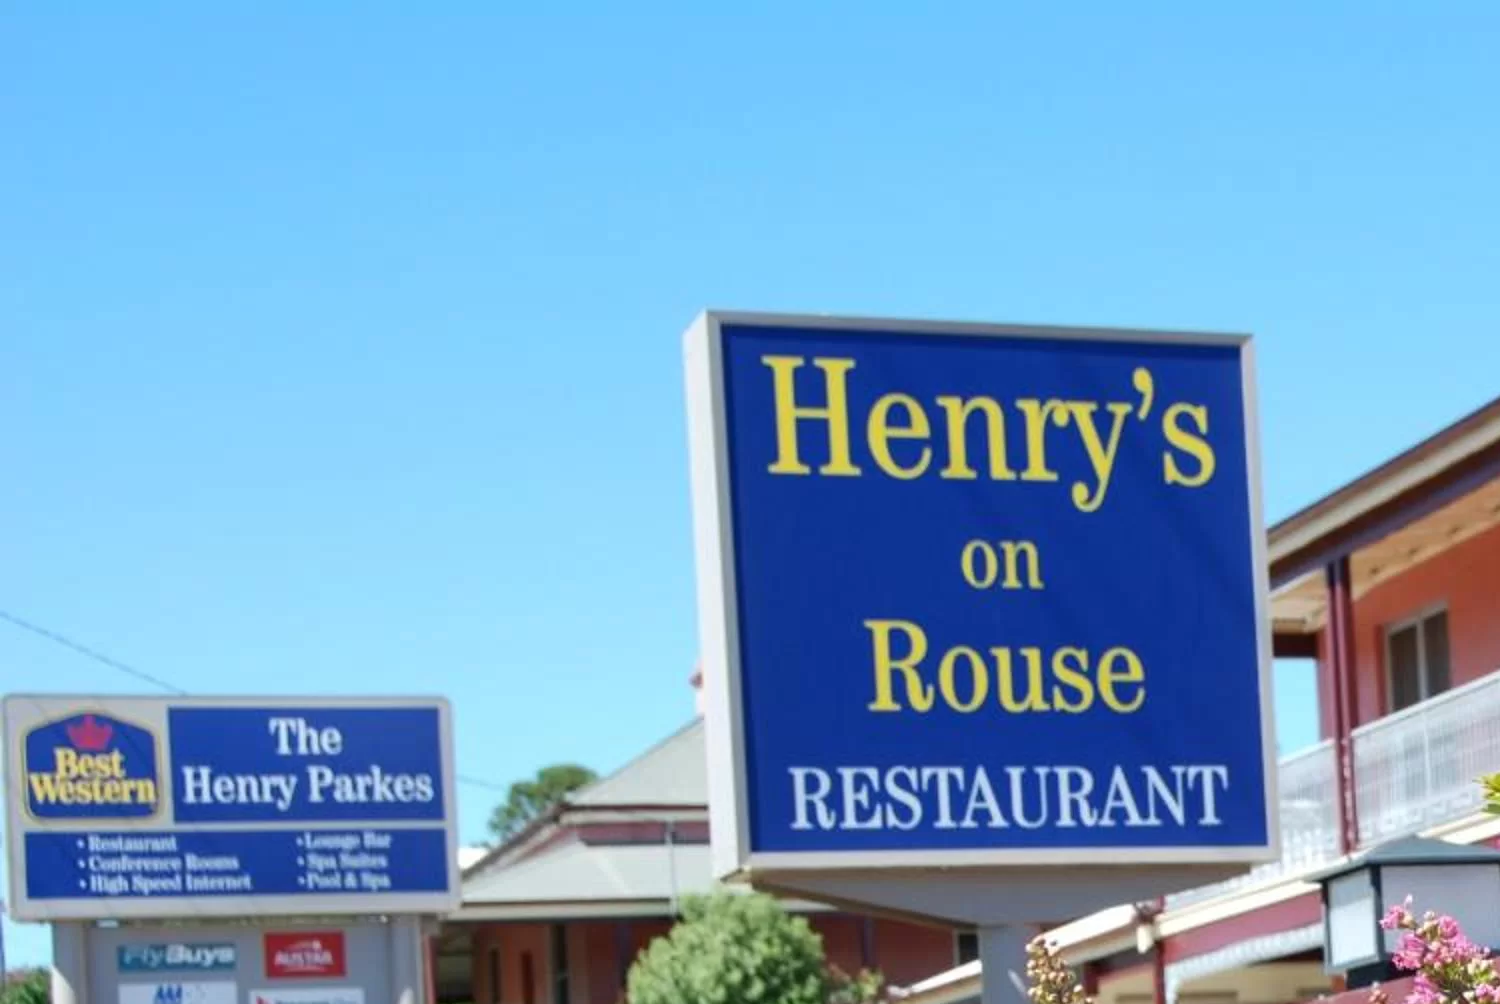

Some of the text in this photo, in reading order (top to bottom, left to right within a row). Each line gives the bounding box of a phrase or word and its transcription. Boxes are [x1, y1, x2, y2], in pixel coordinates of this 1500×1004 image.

[762, 354, 1216, 513] Henry's
[960, 538, 1044, 590] on
[863, 618, 1146, 714] Rouse
[269, 717, 343, 755] The
[54, 747, 125, 778] Best
[29, 773, 156, 805] Western
[181, 765, 434, 812] Henry Parkes
[788, 764, 1229, 831] RESTAURANT
[88, 834, 177, 852] Restaurant
[305, 832, 392, 853] Lounge Bar
[89, 854, 240, 872] Conference Rooms
[306, 853, 388, 872] Spa Suites
[90, 873, 252, 896] High Speed Internet
[306, 873, 392, 891] Pool & Spa
